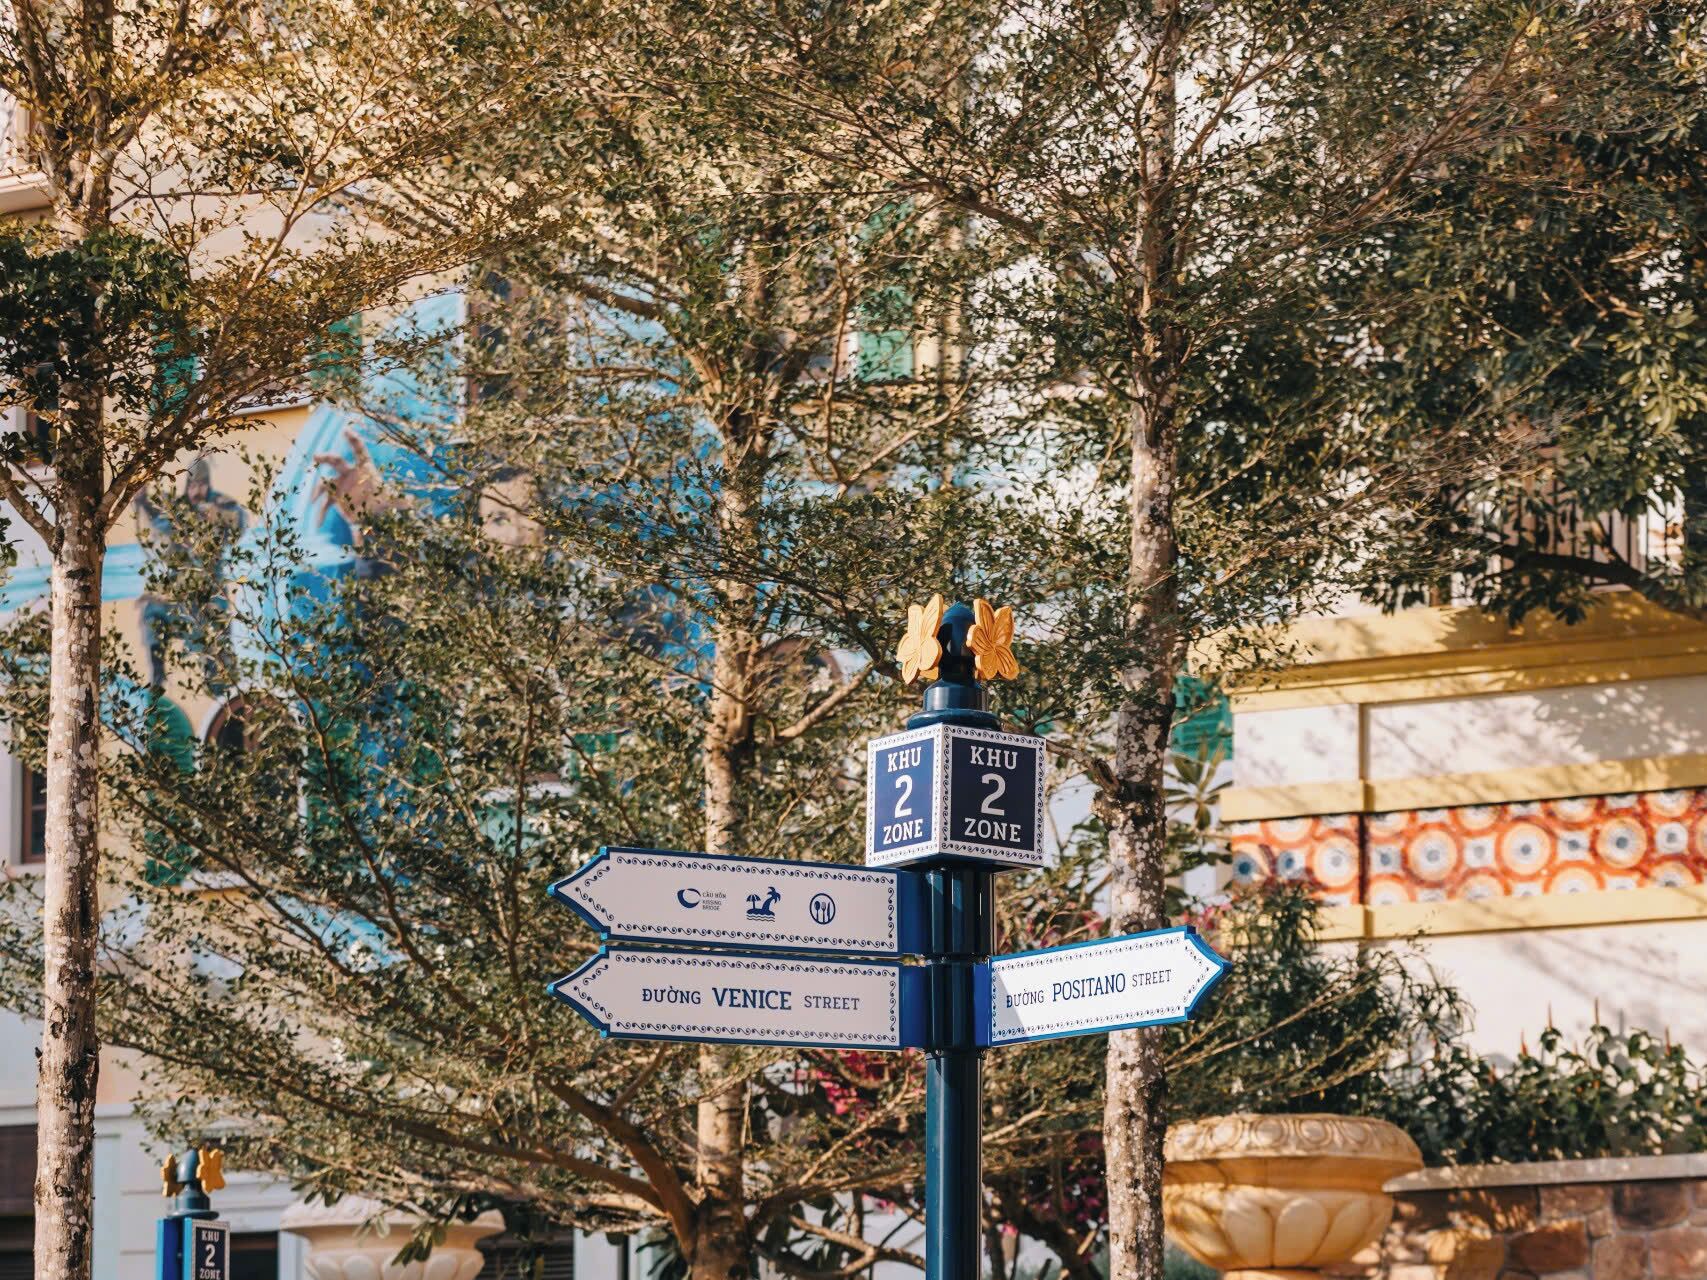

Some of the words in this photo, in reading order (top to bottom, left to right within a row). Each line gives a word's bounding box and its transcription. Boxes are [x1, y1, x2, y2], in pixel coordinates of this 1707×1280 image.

[887, 746, 922, 773] KHU
[970, 745, 1018, 770] KHU
[894, 774, 913, 818] 2
[981, 773, 1006, 816] 2
[883, 818, 923, 845] ZONE
[964, 817, 1021, 843] ZONE
[642, 986, 701, 1005] ĐƯỜNG
[712, 987, 792, 1010] VENICE
[803, 995, 860, 1010] STREET
[1006, 988, 1045, 1008] ĐƯỜNG
[1052, 973, 1126, 1002] POSITANO
[1132, 969, 1172, 988] STREET
[201, 1230, 220, 1242] KHU
[205, 1243, 216, 1267] 2
[200, 1268, 221, 1280] ZONE
